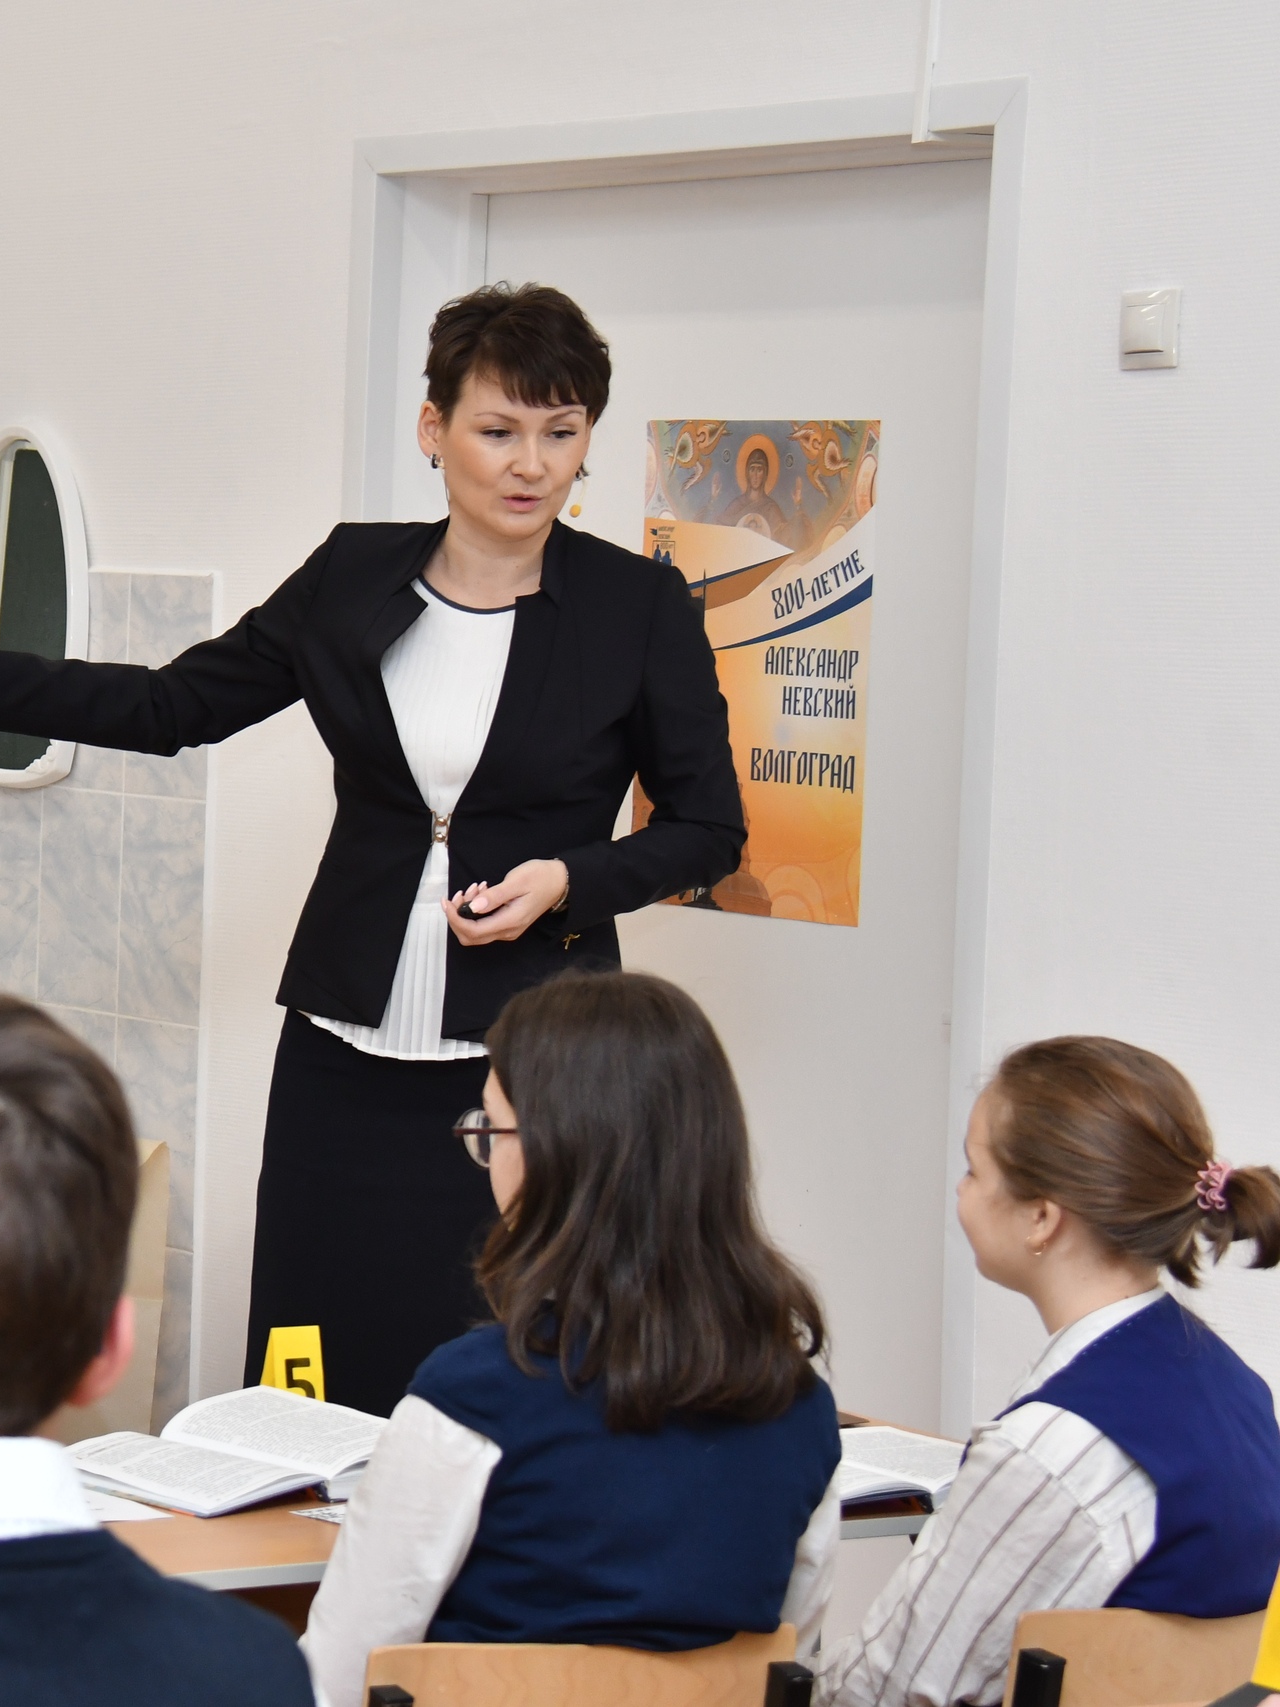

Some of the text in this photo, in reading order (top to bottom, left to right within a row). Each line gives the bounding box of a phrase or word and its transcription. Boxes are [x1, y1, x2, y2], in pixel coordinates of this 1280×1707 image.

[771, 549, 865, 620] 800-ЛЕТИЕ
[765, 646, 859, 683] АЛЕКСАНДР
[782, 684, 856, 720] НЕВСКИЙ
[750, 748, 855, 794] ВОЛГОГРАД
[285, 1357, 316, 1399] 5
